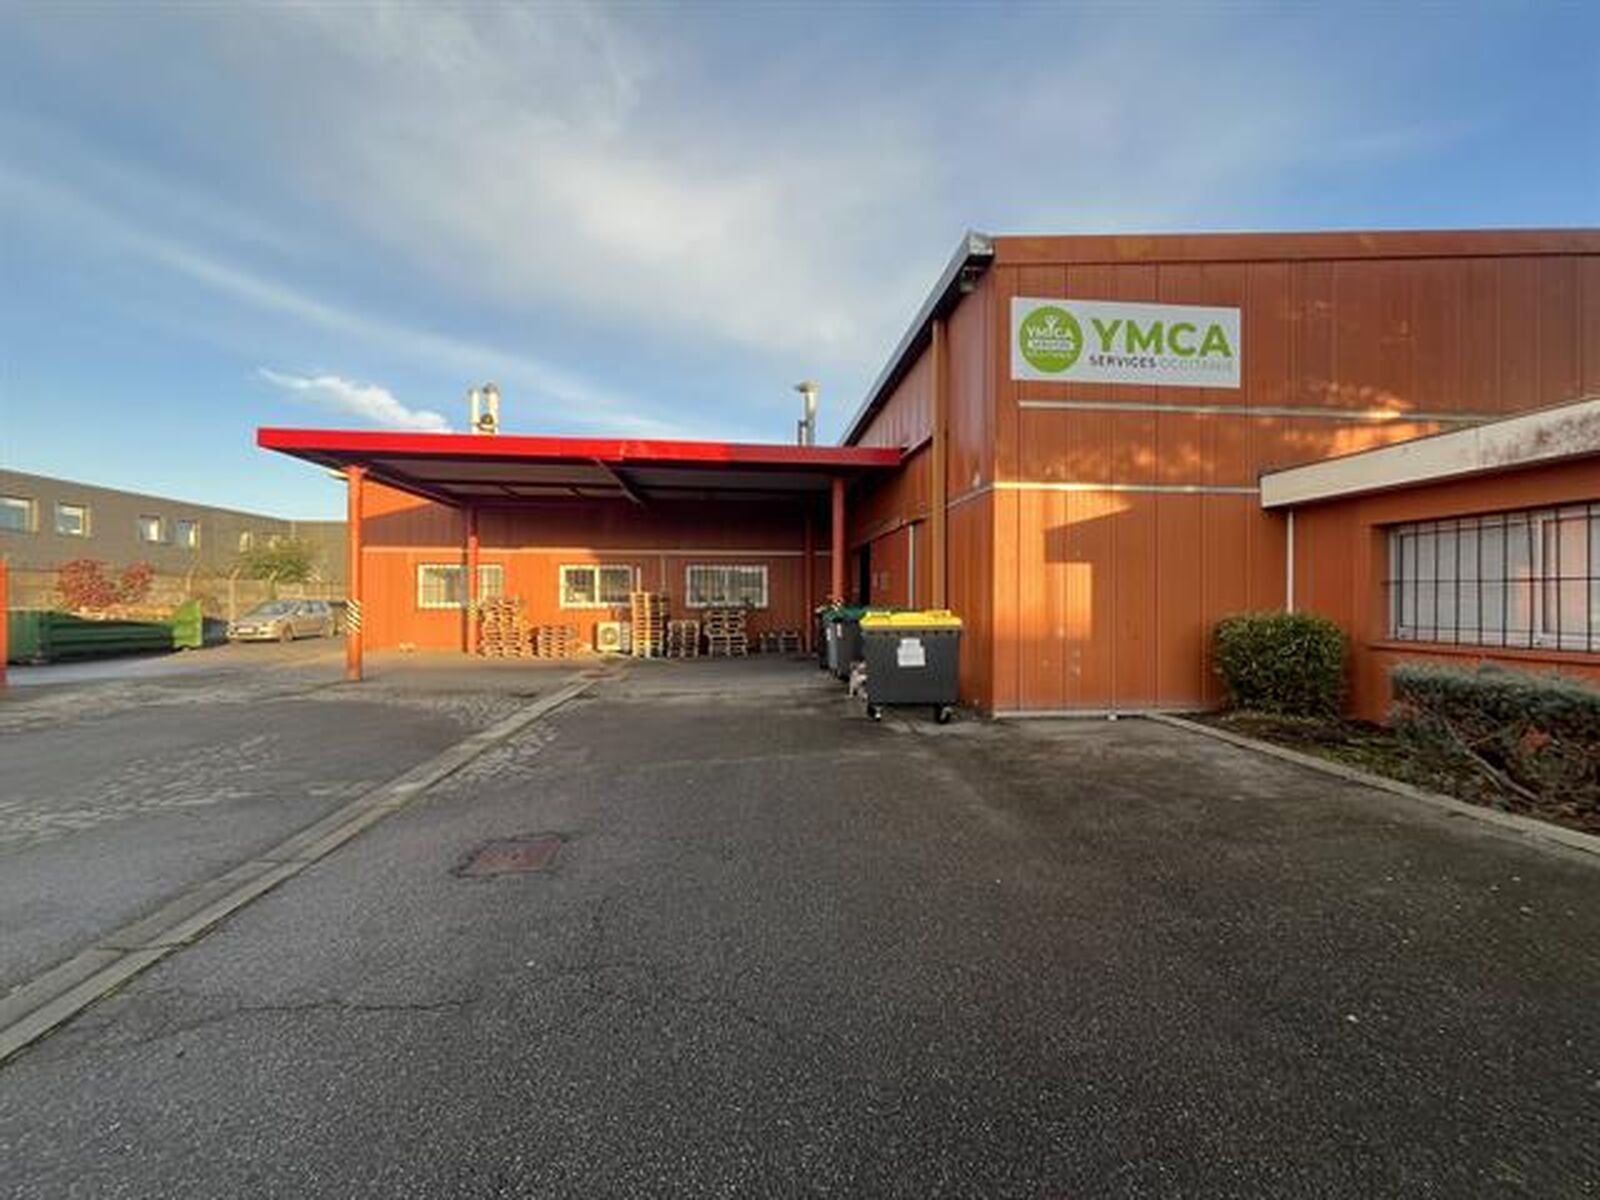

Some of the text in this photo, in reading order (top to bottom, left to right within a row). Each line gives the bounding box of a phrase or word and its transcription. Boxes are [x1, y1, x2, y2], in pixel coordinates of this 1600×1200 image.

[1026, 321, 1073, 339] YMCA
[1091, 319, 1231, 357] YMCA
[1089, 355, 1157, 369] SERVICES
